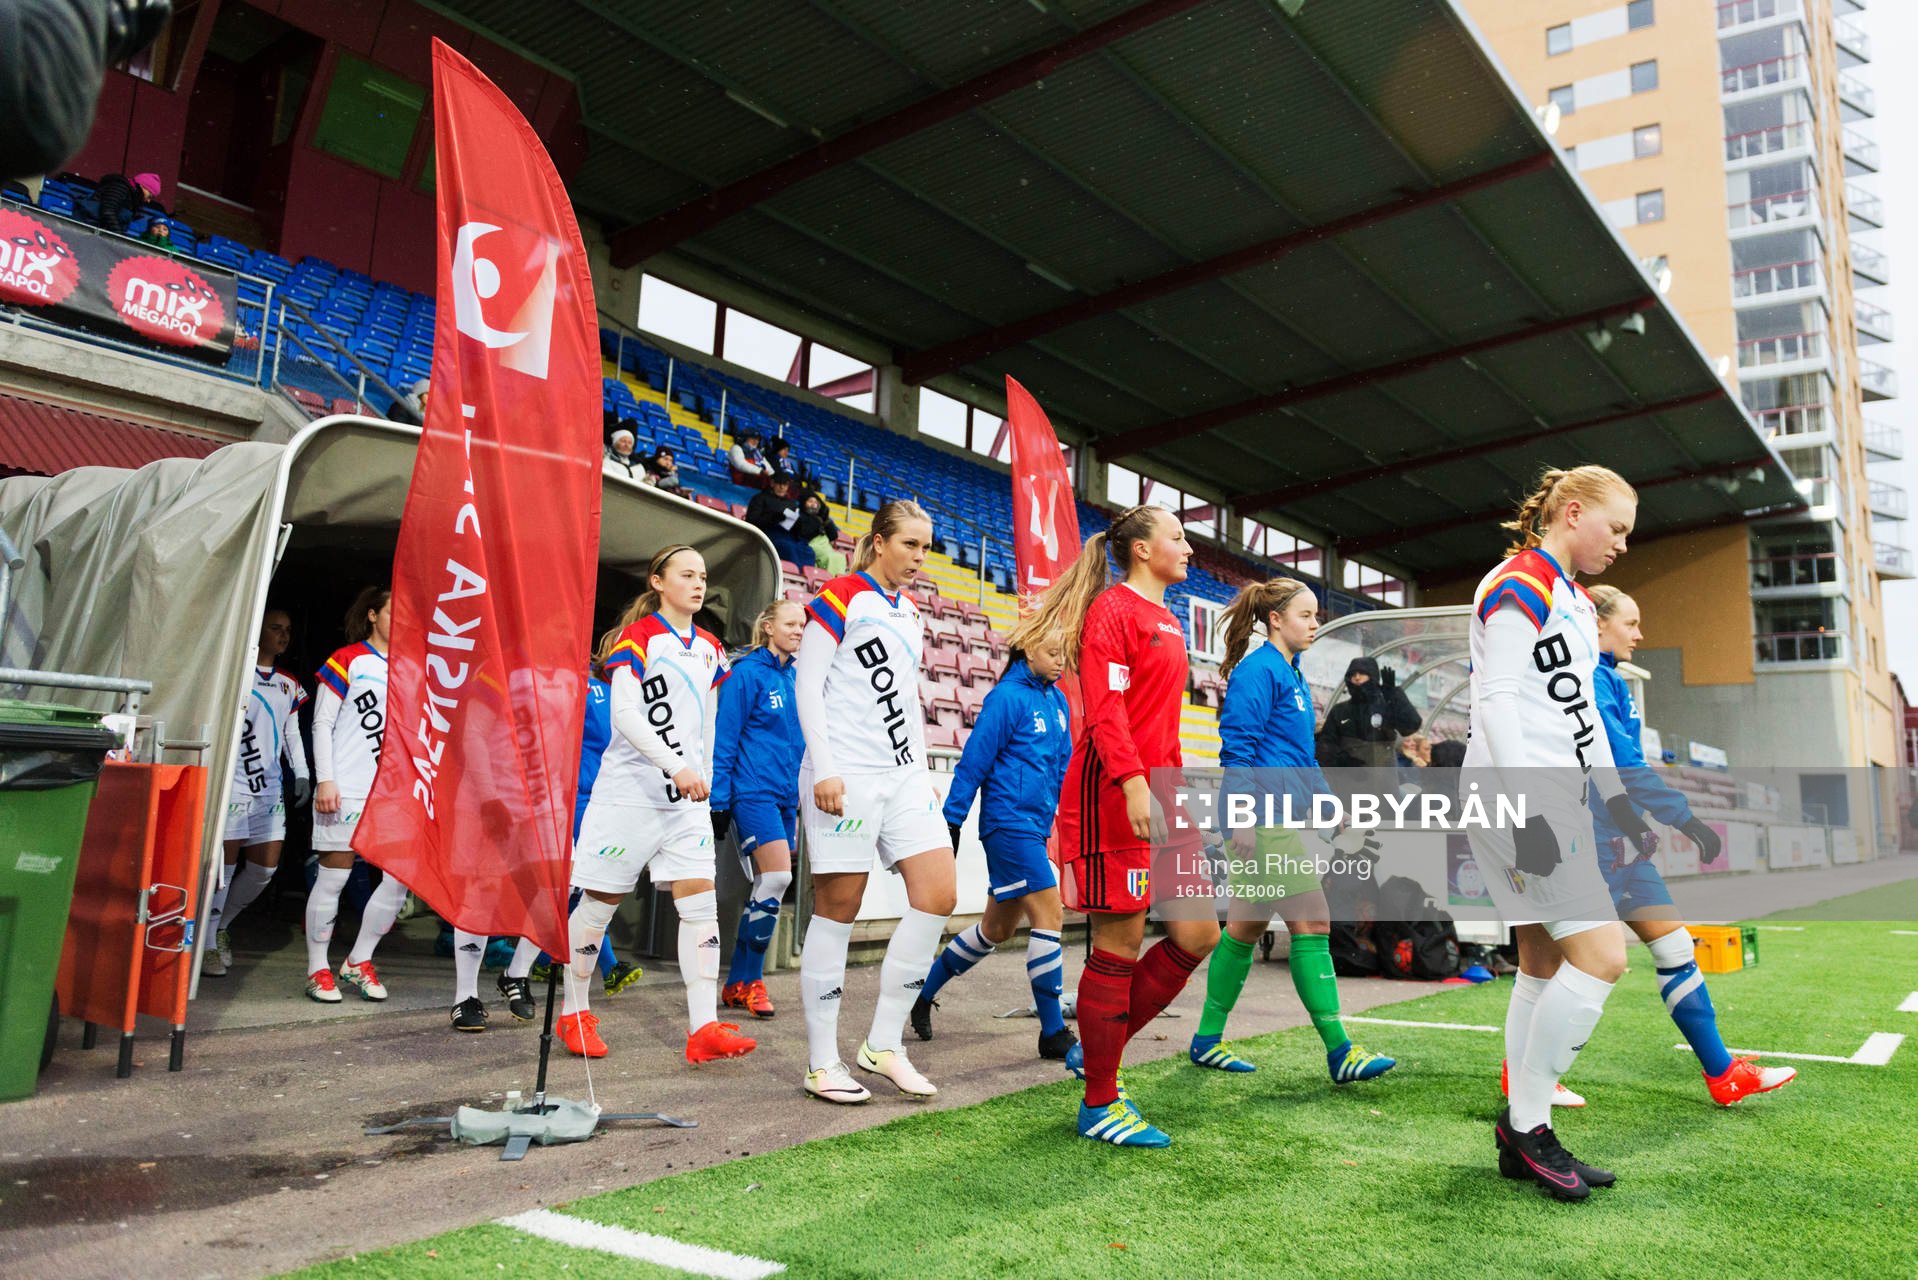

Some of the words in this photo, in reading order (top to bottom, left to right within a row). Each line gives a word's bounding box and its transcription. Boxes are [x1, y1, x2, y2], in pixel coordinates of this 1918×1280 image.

[0, 237, 61, 285] ix
[122, 301, 199, 340] MEGAPOL
[125, 277, 209, 327] mix
[769, 694, 784, 709] 31
[240, 717, 268, 794] OHUS
[641, 673, 682, 803] BOHS
